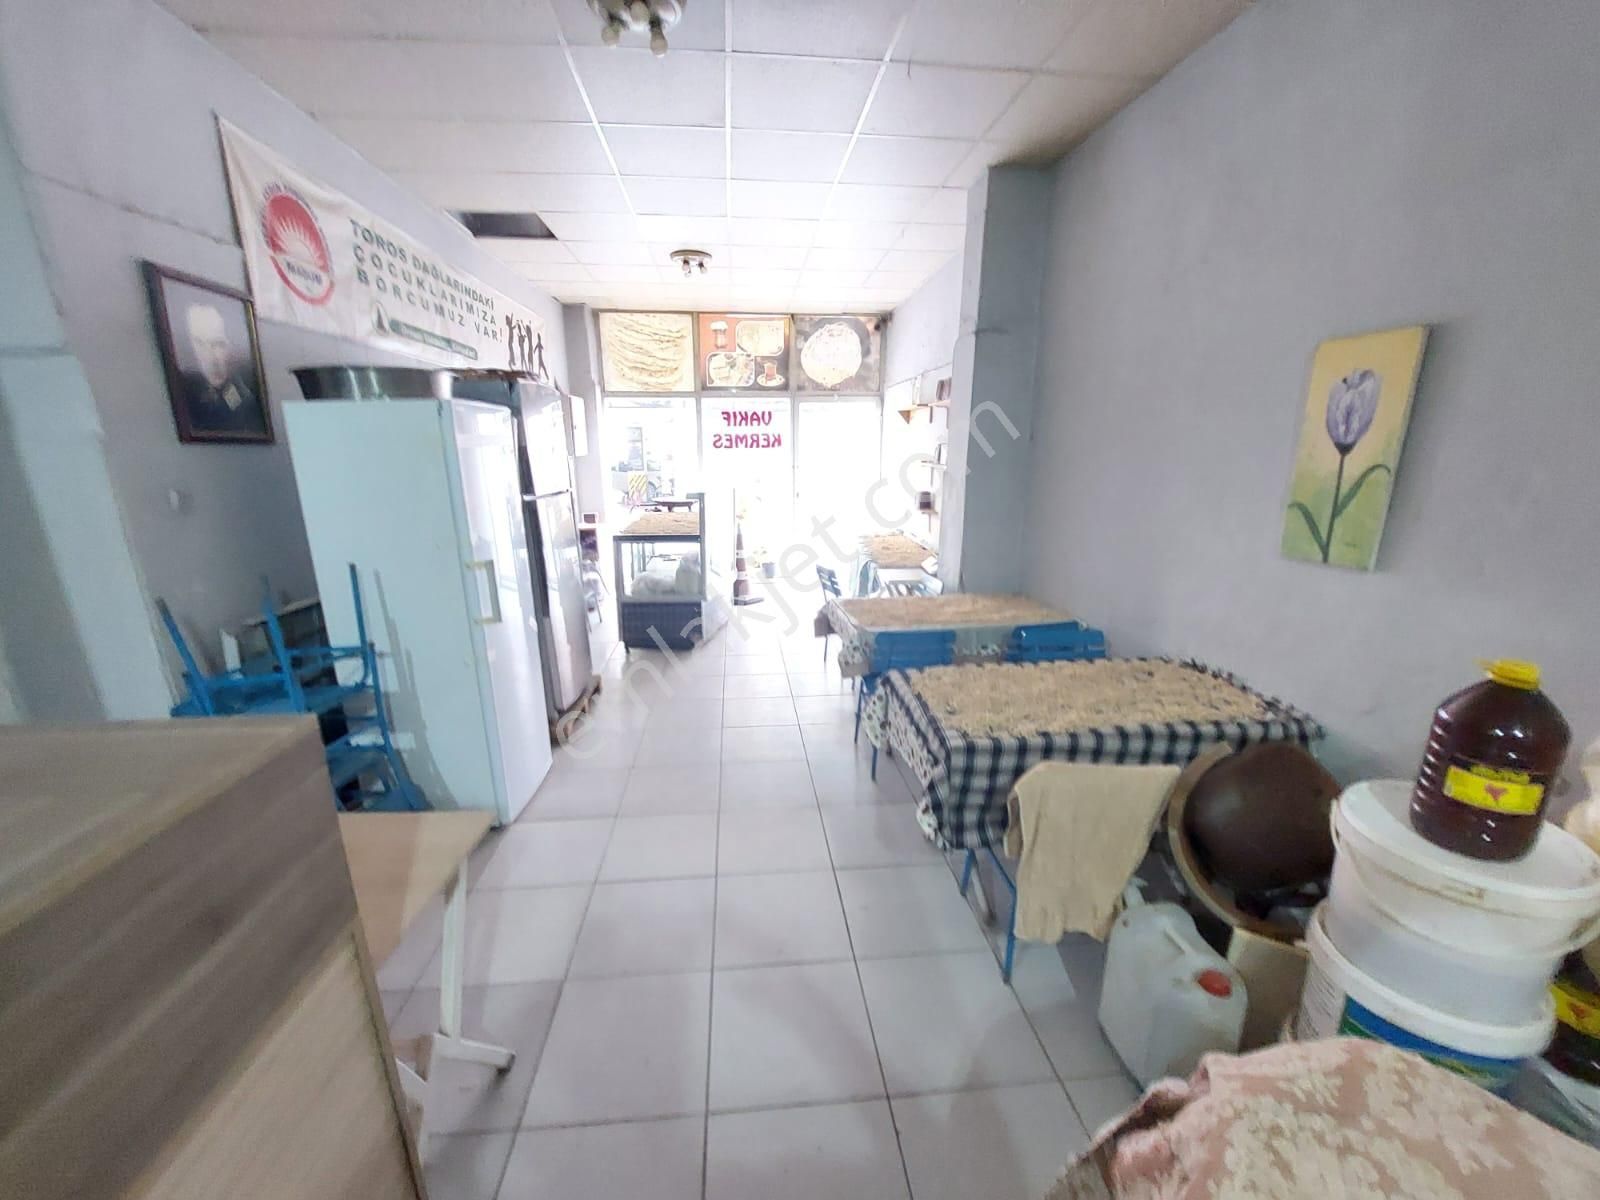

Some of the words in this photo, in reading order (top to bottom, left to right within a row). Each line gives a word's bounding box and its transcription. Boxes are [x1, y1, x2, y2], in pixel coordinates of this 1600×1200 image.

[348, 217, 407, 263] TOROS
[412, 254, 494, 310] DAĞLARINDAKİ
[353, 245, 496, 325] ÇOCUKLARIMIZA
[355, 266, 465, 327] BORCUMUZ
[474, 321, 503, 343] VAR!
